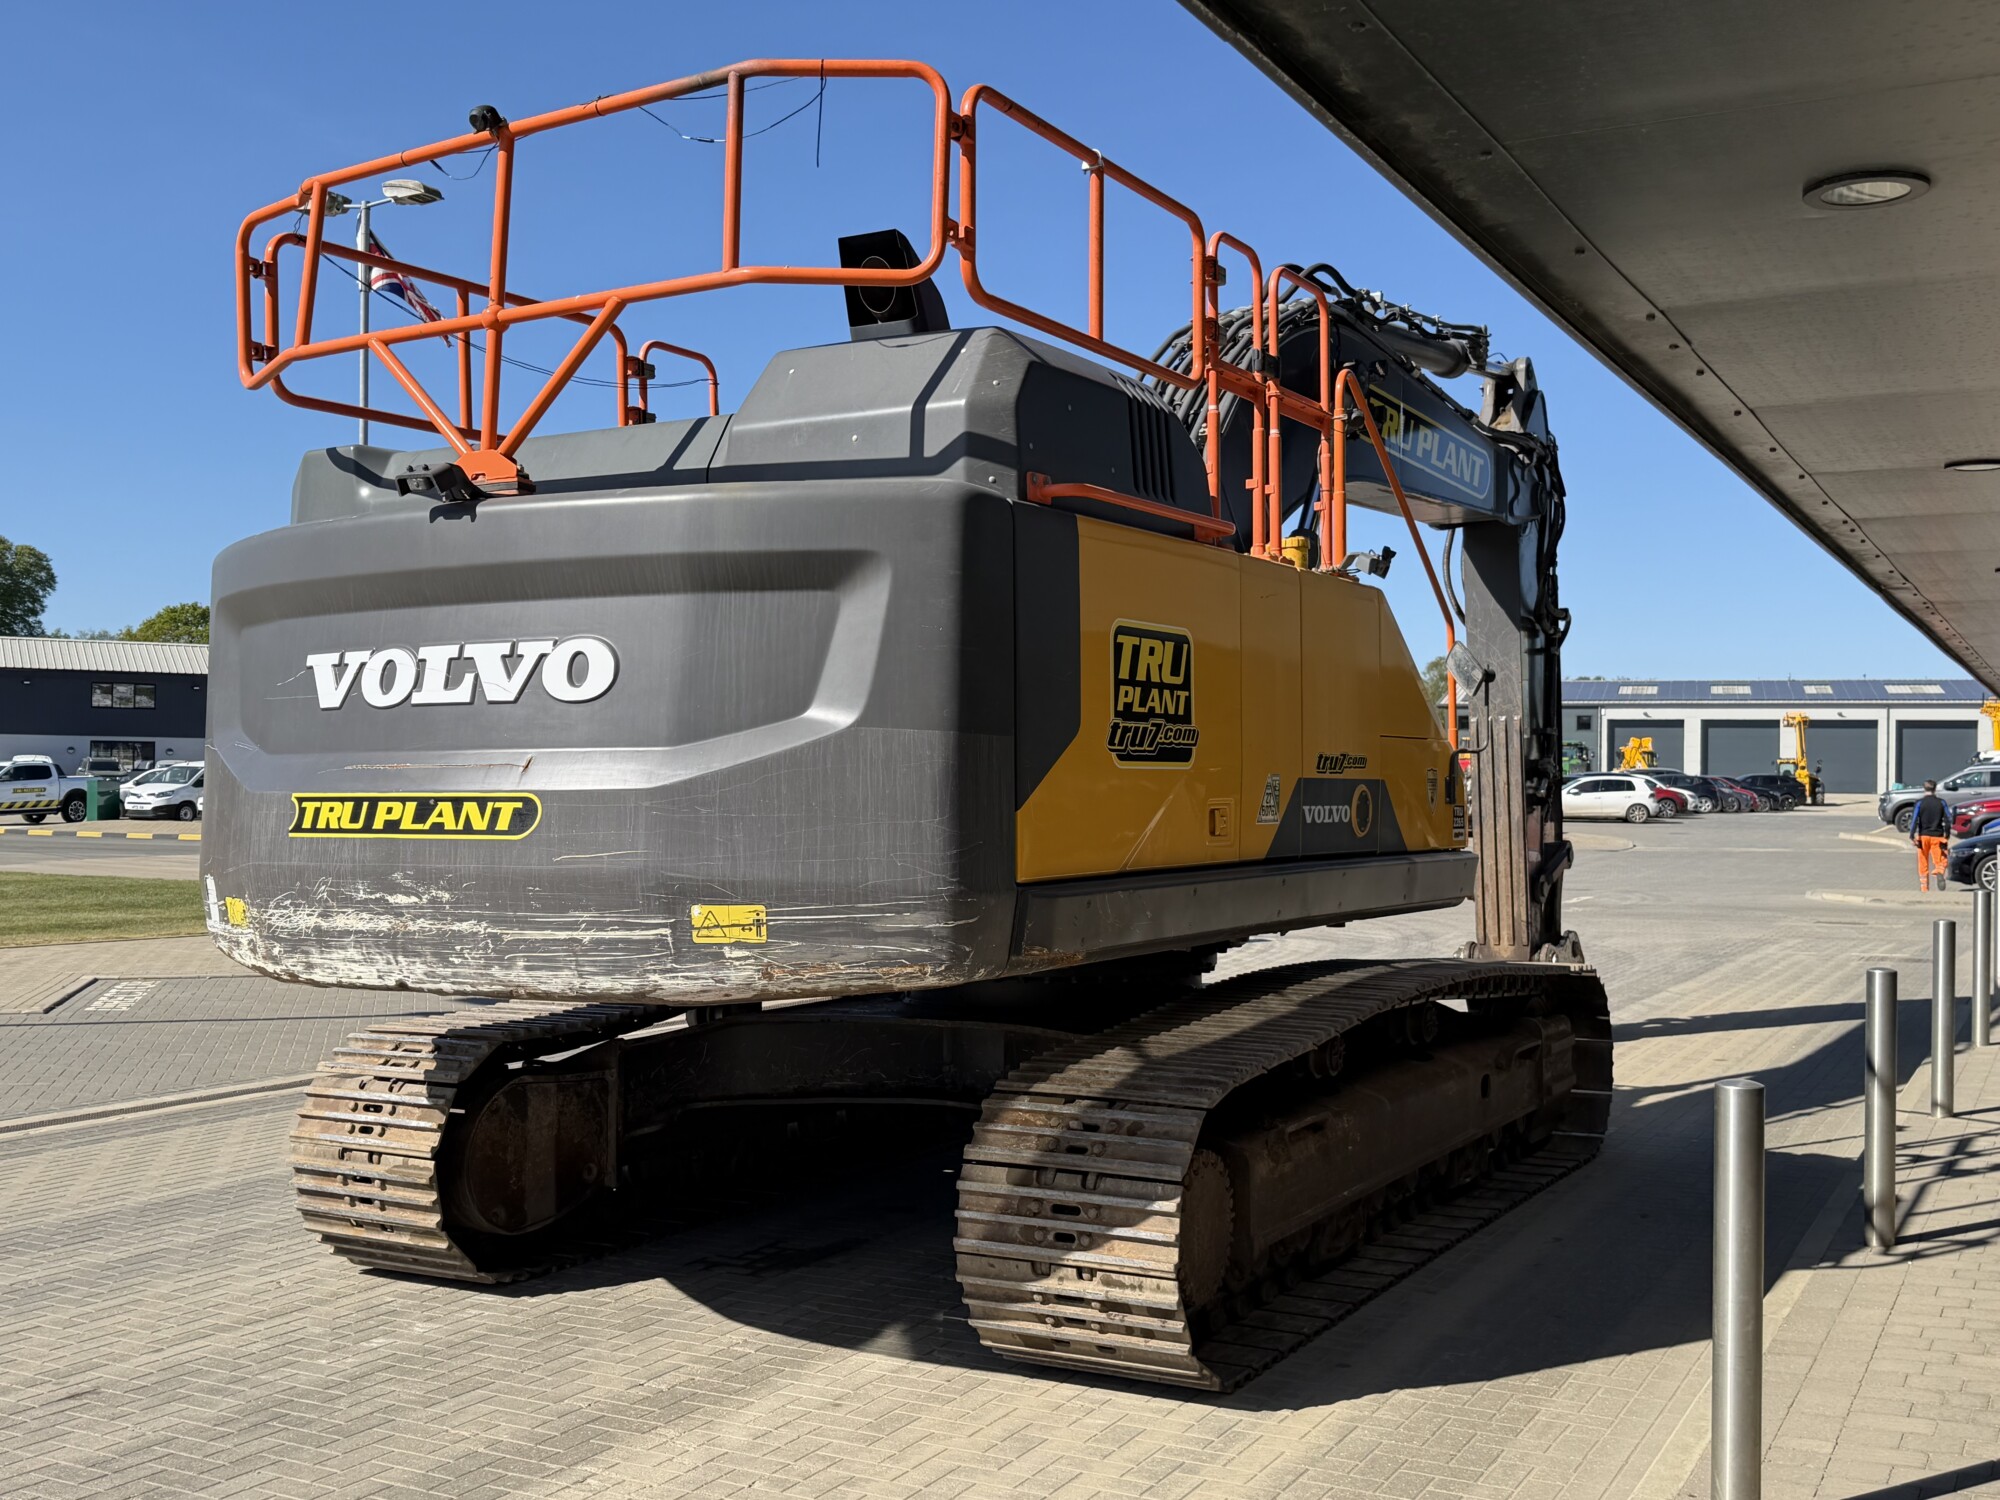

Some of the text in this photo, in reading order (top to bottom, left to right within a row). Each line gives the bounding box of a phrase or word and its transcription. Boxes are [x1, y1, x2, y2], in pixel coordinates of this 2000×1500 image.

[1416, 424, 1485, 488] PLANT
[305, 637, 617, 710] VOLVO
[1116, 634, 1188, 685] TRU
[1116, 685, 1189, 716] PLANT
[1107, 720, 1198, 753] tru7.com
[1316, 753, 1367, 774] tru7.com
[301, 800, 524, 830] TRU PLANT
[1303, 804, 1350, 824] VOLVO
